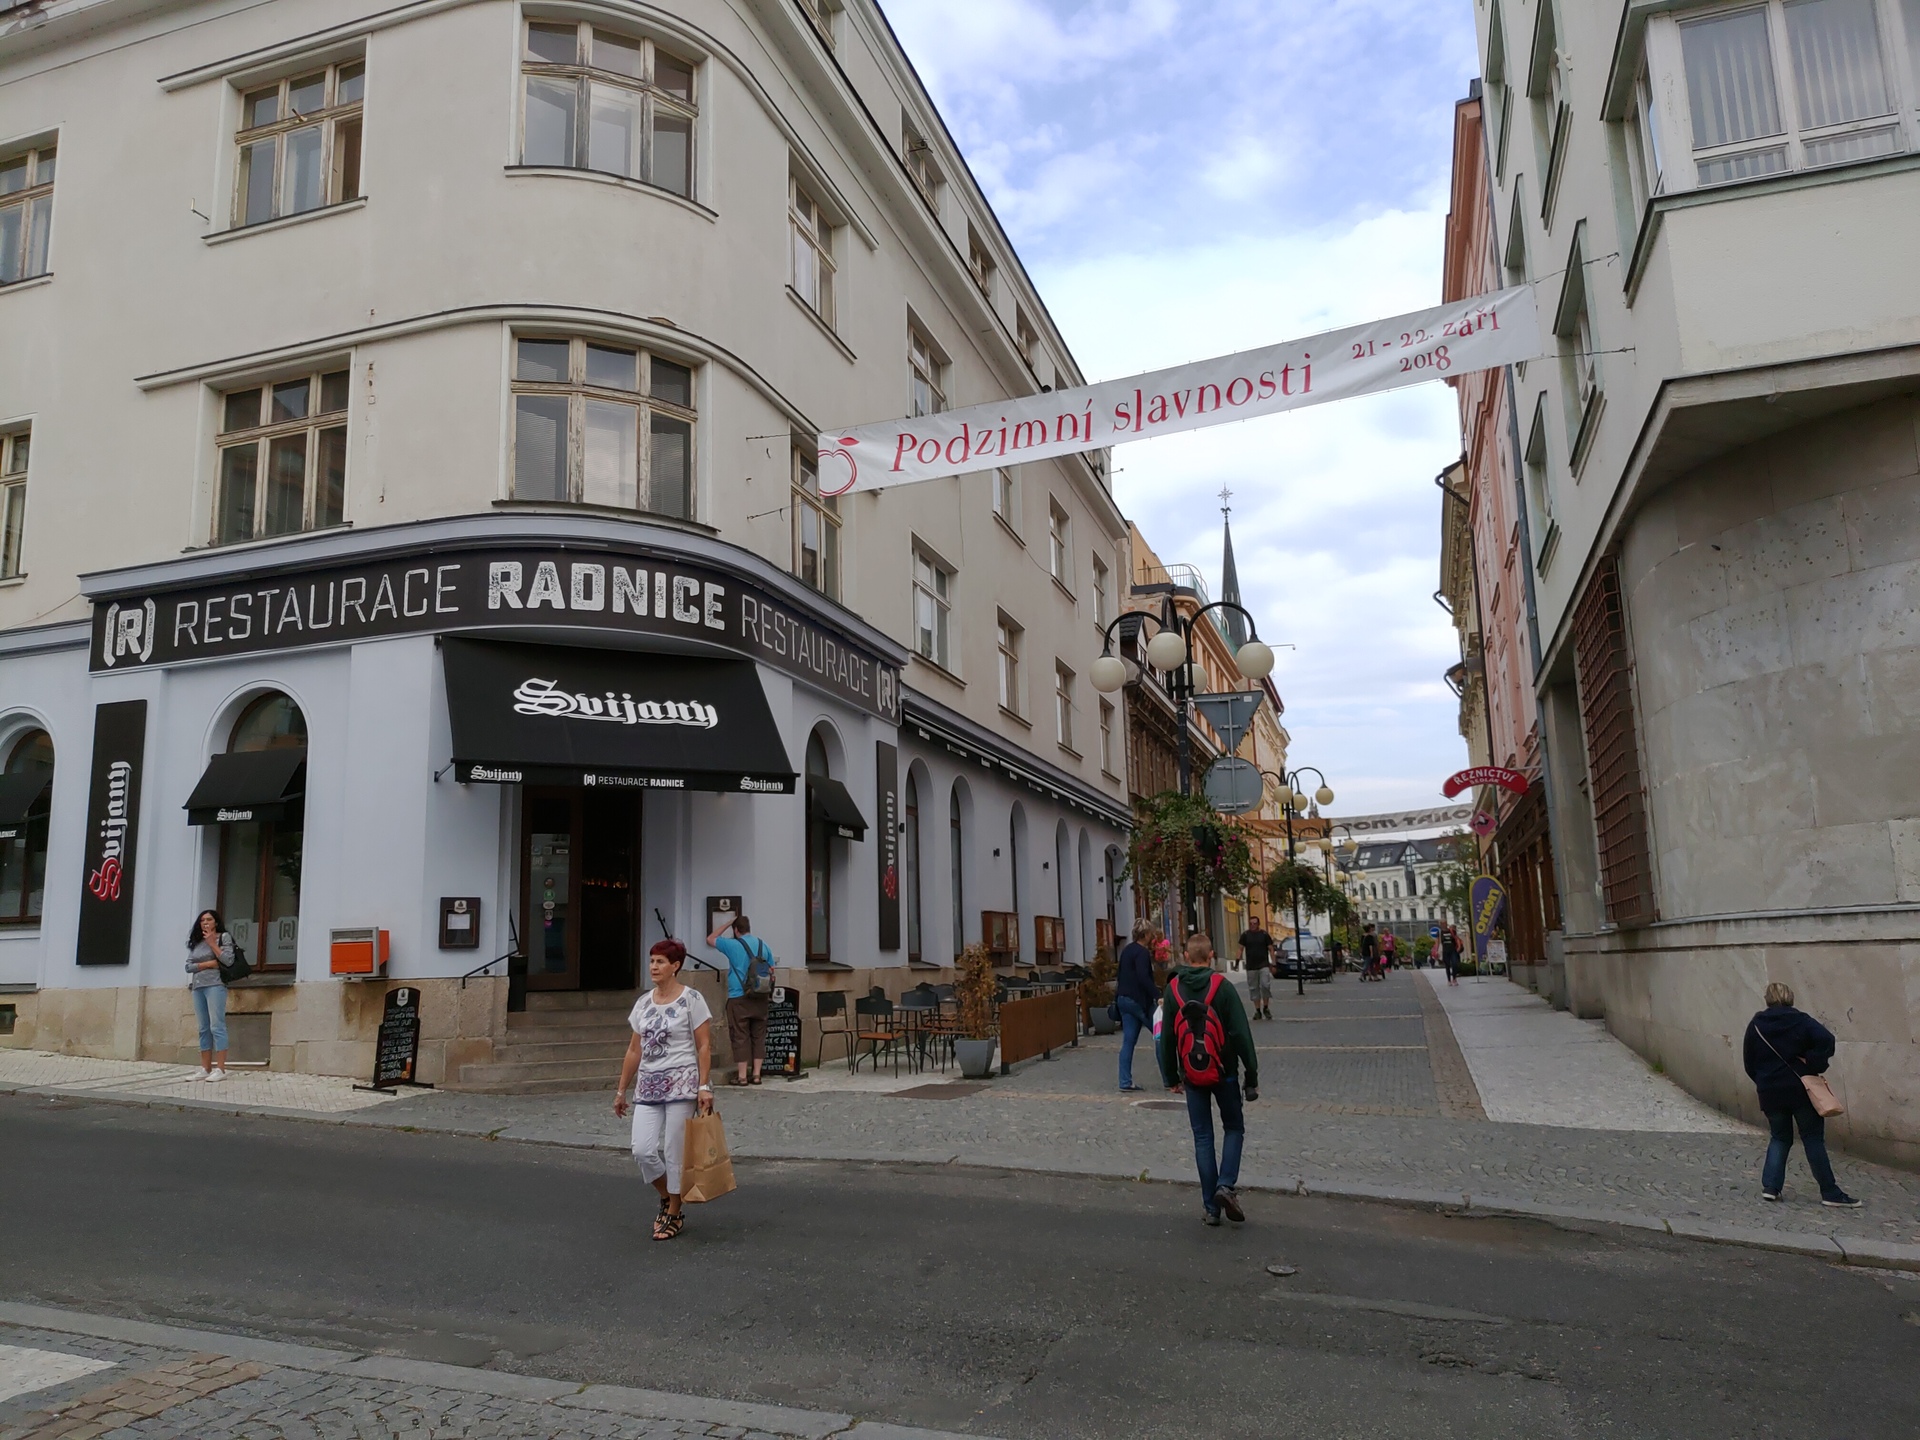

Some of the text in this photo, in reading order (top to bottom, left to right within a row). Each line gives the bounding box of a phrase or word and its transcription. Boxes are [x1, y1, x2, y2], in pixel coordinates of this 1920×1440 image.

[1352, 339, 1376, 361] 21
[1400, 328, 1434, 349] 22.
[1442, 304, 1500, 338] září
[1400, 345, 1451, 373] 2018
[889, 353, 1314, 472] Podzimní slavnosti
[173, 564, 461, 648] RESTAURACE
[488, 561, 725, 630] RADNICE
[741, 594, 870, 698] RESTAURACE
[513, 678, 718, 729] Svijany
[470, 766, 522, 782] Svijany
[598, 775, 648, 787] RESTAURACE
[650, 777, 684, 788] RADNICE
[740, 776, 784, 792] Svijany
[217, 808, 252, 821] Svijany
[1403, 809, 1474, 825] TAILO
[89, 761, 132, 901] Svijany
